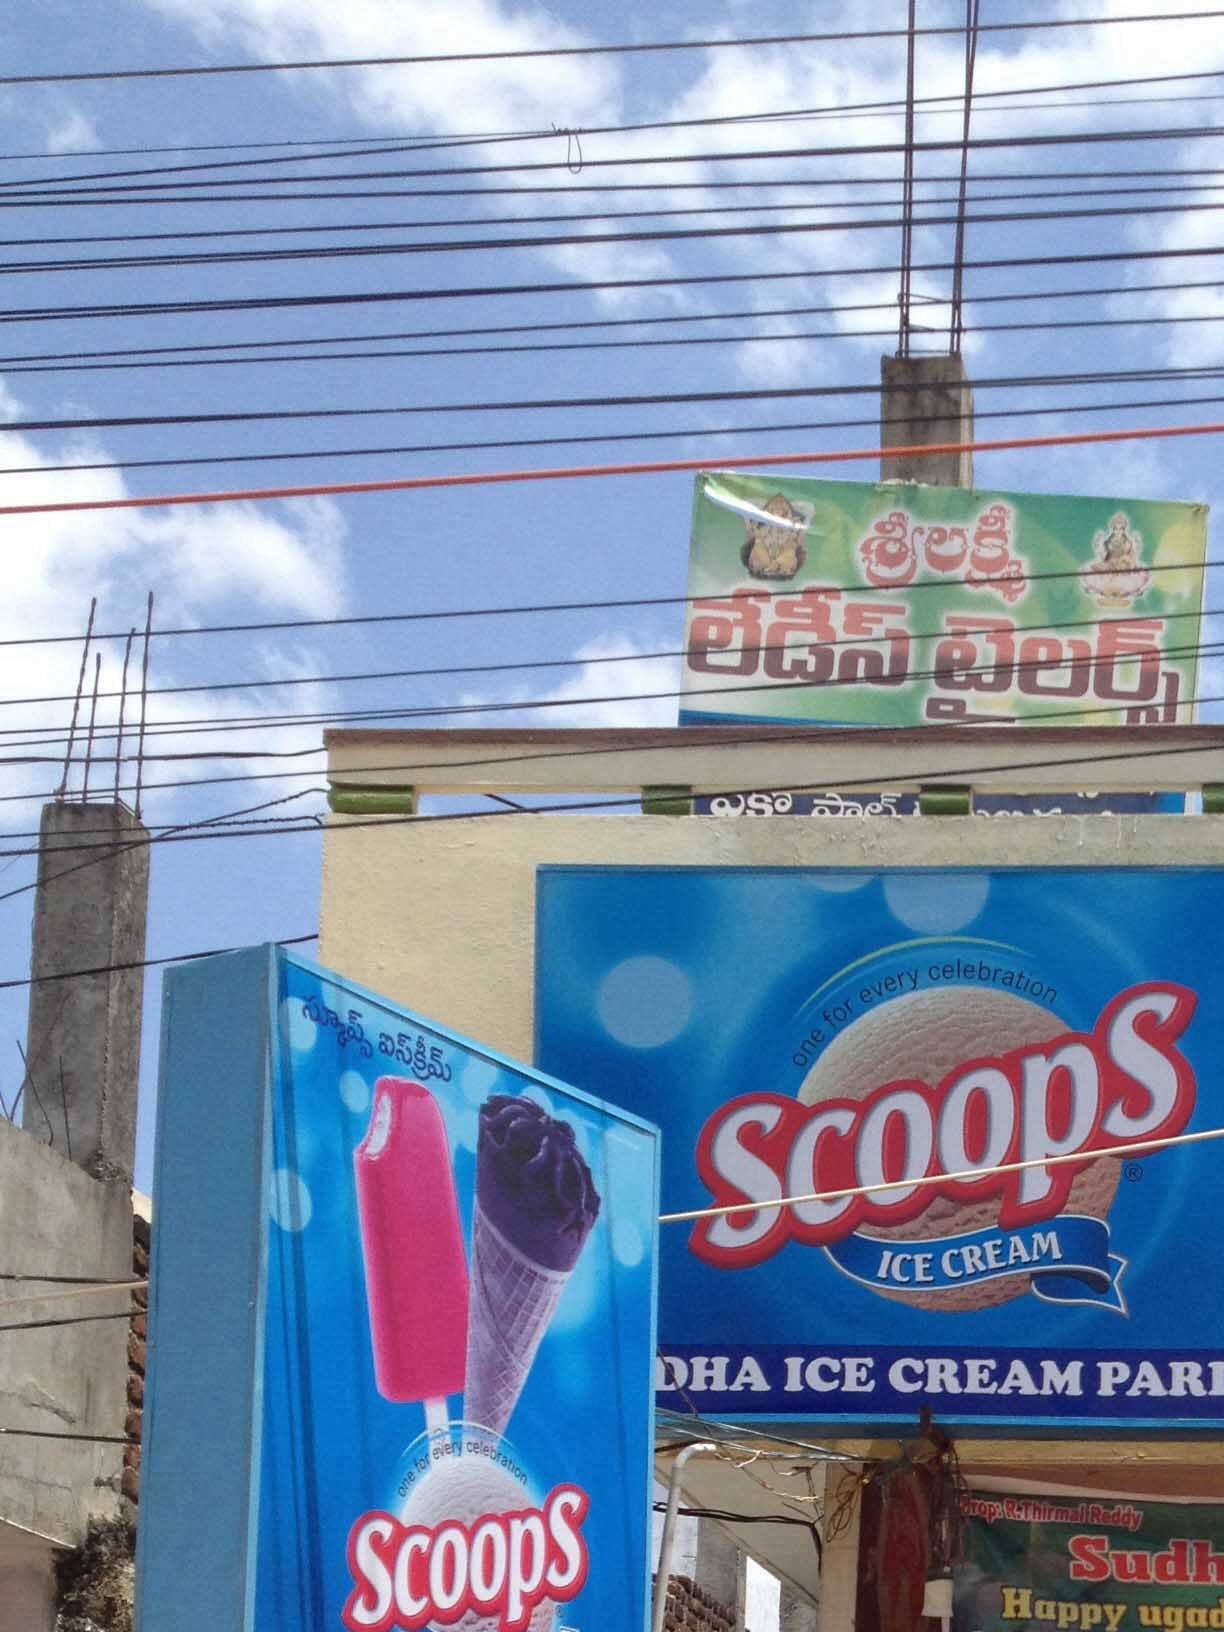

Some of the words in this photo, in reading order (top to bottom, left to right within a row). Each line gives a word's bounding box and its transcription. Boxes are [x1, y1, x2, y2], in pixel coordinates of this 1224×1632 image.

[793, 1028, 826, 1068] one
[821, 999, 855, 1031] for
[858, 967, 920, 1004] every
[927, 958, 1058, 1005] celebration
[876, 1249, 935, 1283] ICE
[940, 1230, 1063, 1277] CREAM
[783, 1356, 876, 1393] ICE
[889, 1357, 1085, 1396] CREAM
[397, 1470, 417, 1498] one
[414, 1454, 431, 1473] for
[432, 1439, 463, 1461] every
[466, 1440, 528, 1486] celebration
[1089, 1503, 1143, 1532] Reddy
[1000, 1586, 1128, 1632] Happy
